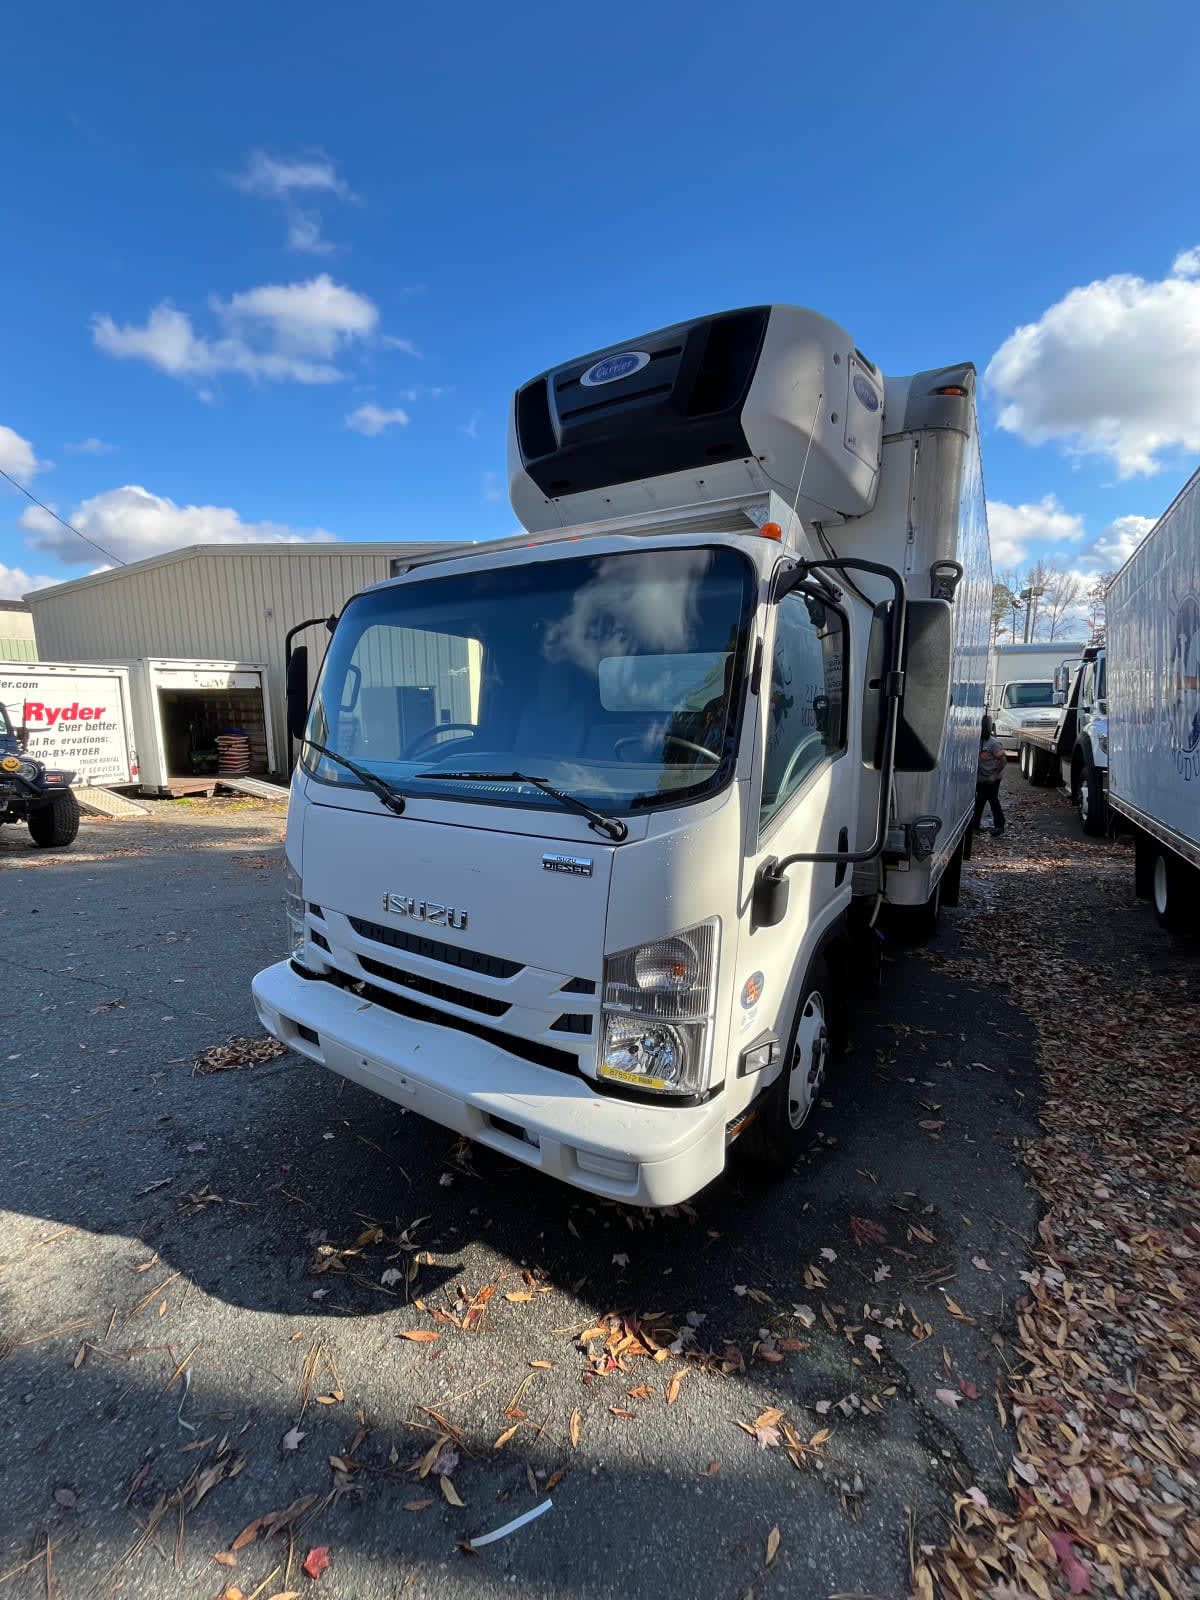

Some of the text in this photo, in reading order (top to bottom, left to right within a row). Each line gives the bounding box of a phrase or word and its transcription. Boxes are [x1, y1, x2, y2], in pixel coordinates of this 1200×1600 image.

[0, 680, 39, 689] er.com
[24, 702, 106, 725] Ryder
[58, 722, 83, 732] Ever
[543, 861, 592, 878] DIESEL
[383, 891, 468, 930] ISUZU
